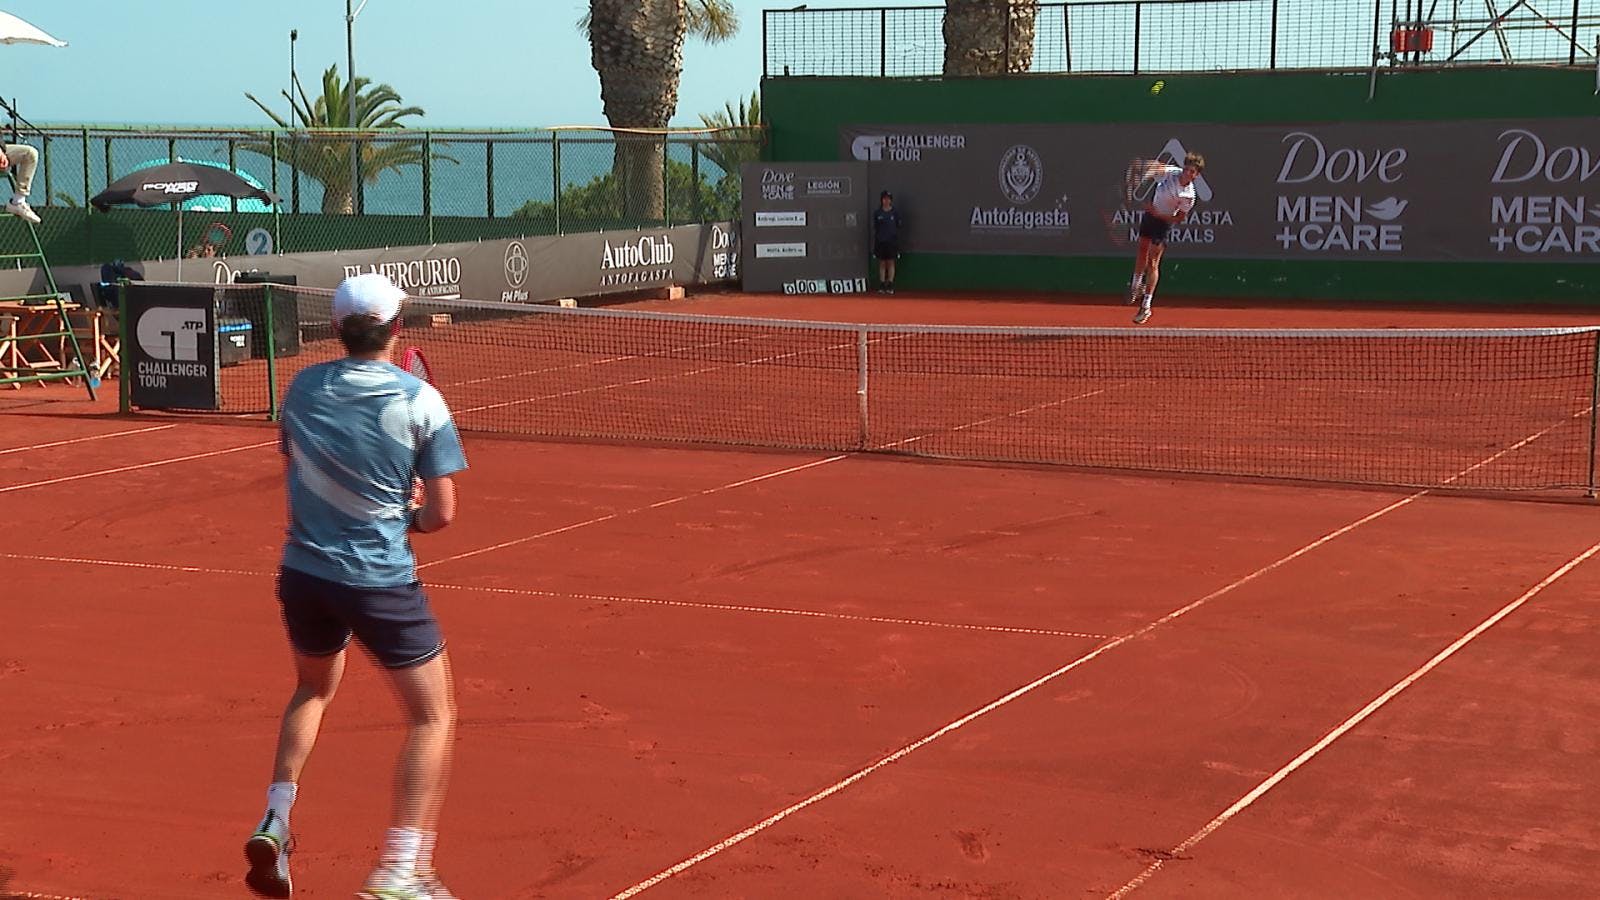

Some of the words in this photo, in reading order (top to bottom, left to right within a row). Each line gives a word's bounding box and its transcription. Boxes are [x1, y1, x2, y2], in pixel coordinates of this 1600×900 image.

[888, 135, 966, 148] CHALLENGER
[889, 148, 921, 161] TOUR
[1277, 131, 1408, 183] Dove
[1491, 129, 1600, 183] Dov
[761, 168, 795, 183] Dove
[143, 181, 198, 190] POWER
[762, 185, 784, 193] MEN
[807, 180, 840, 190] LEGIÓN
[1277, 196, 1361, 222] MEN
[1491, 196, 1585, 224] MEN
[970, 206, 1070, 229] Antofagasta
[1111, 210, 1233, 226] ANTASTA
[252, 232, 268, 255] 2
[1129, 228, 1215, 243] MRALS
[1276, 223, 1403, 250] +CARE
[1489, 225, 1600, 253] +CAR
[600, 235, 674, 269] AutoClub
[600, 269, 673, 287] ANTOFAGASTA
[501, 291, 513, 303] FM
[137, 362, 208, 377] CHALLENGER
[138, 374, 168, 388] TOUR
